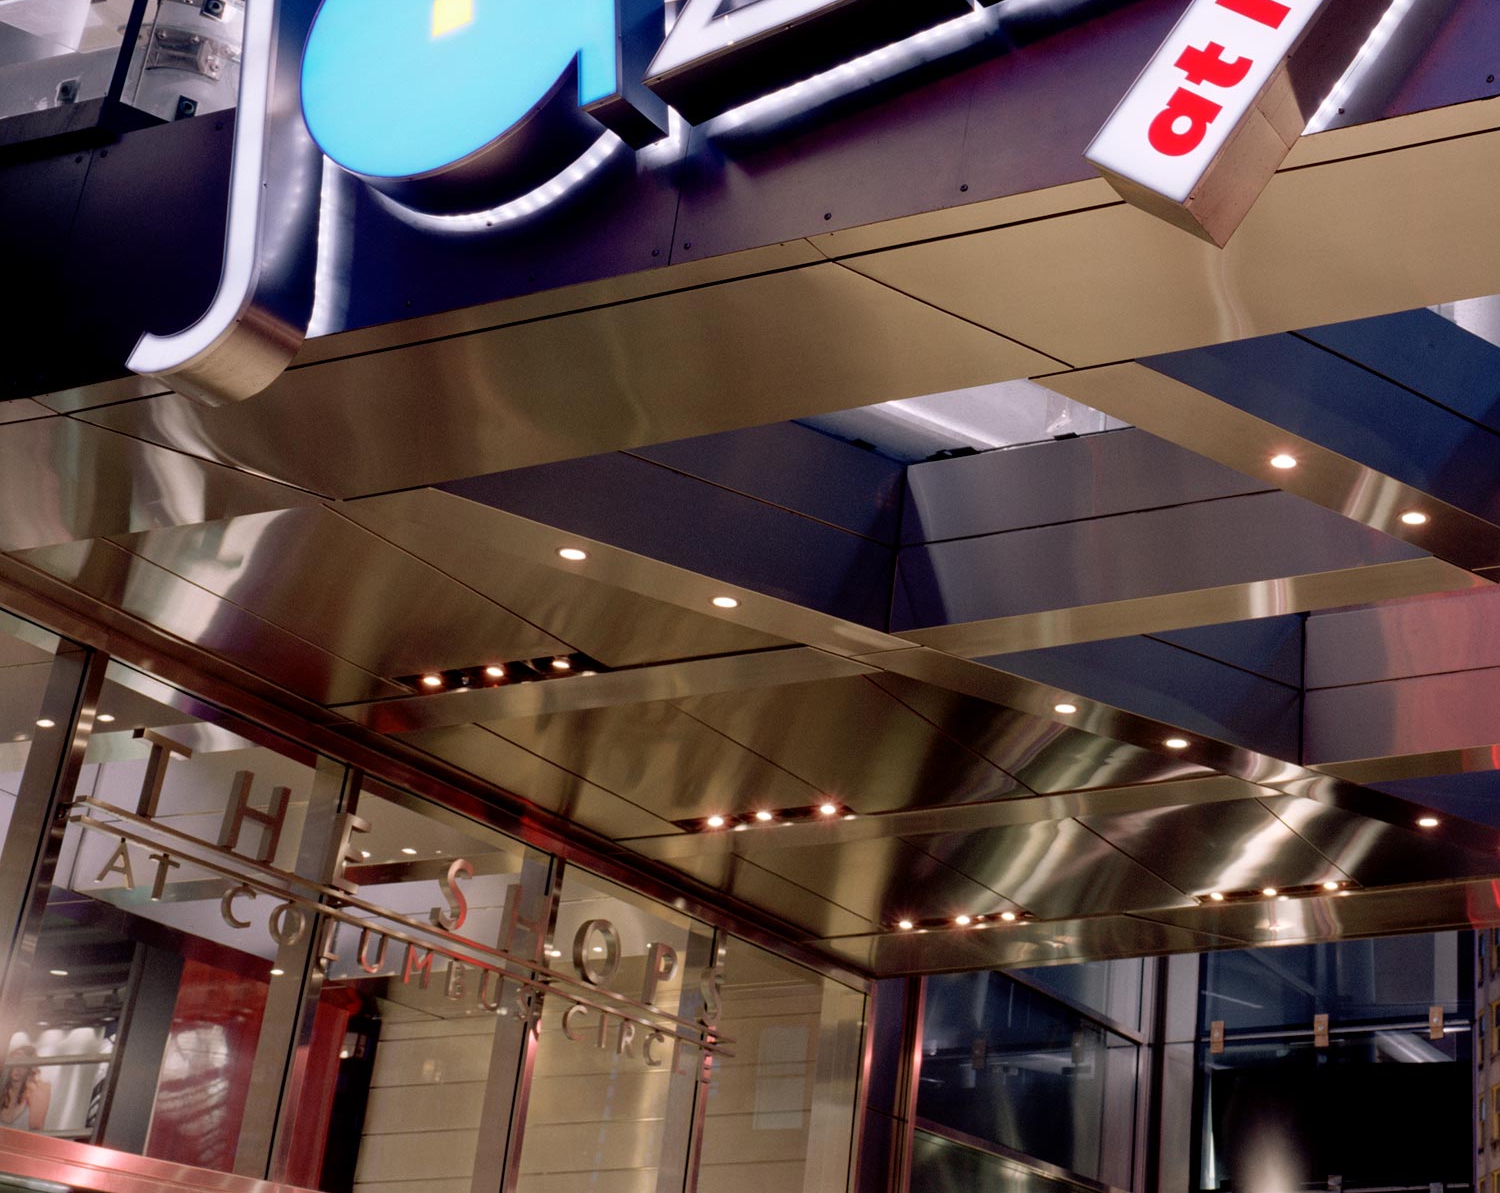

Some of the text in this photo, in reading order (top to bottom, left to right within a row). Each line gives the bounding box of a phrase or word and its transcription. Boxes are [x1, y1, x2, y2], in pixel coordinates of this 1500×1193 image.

[1147, 40, 1254, 158] at
[94, 837, 181, 902] AT
[132, 727, 726, 1027] THE SHOPS
